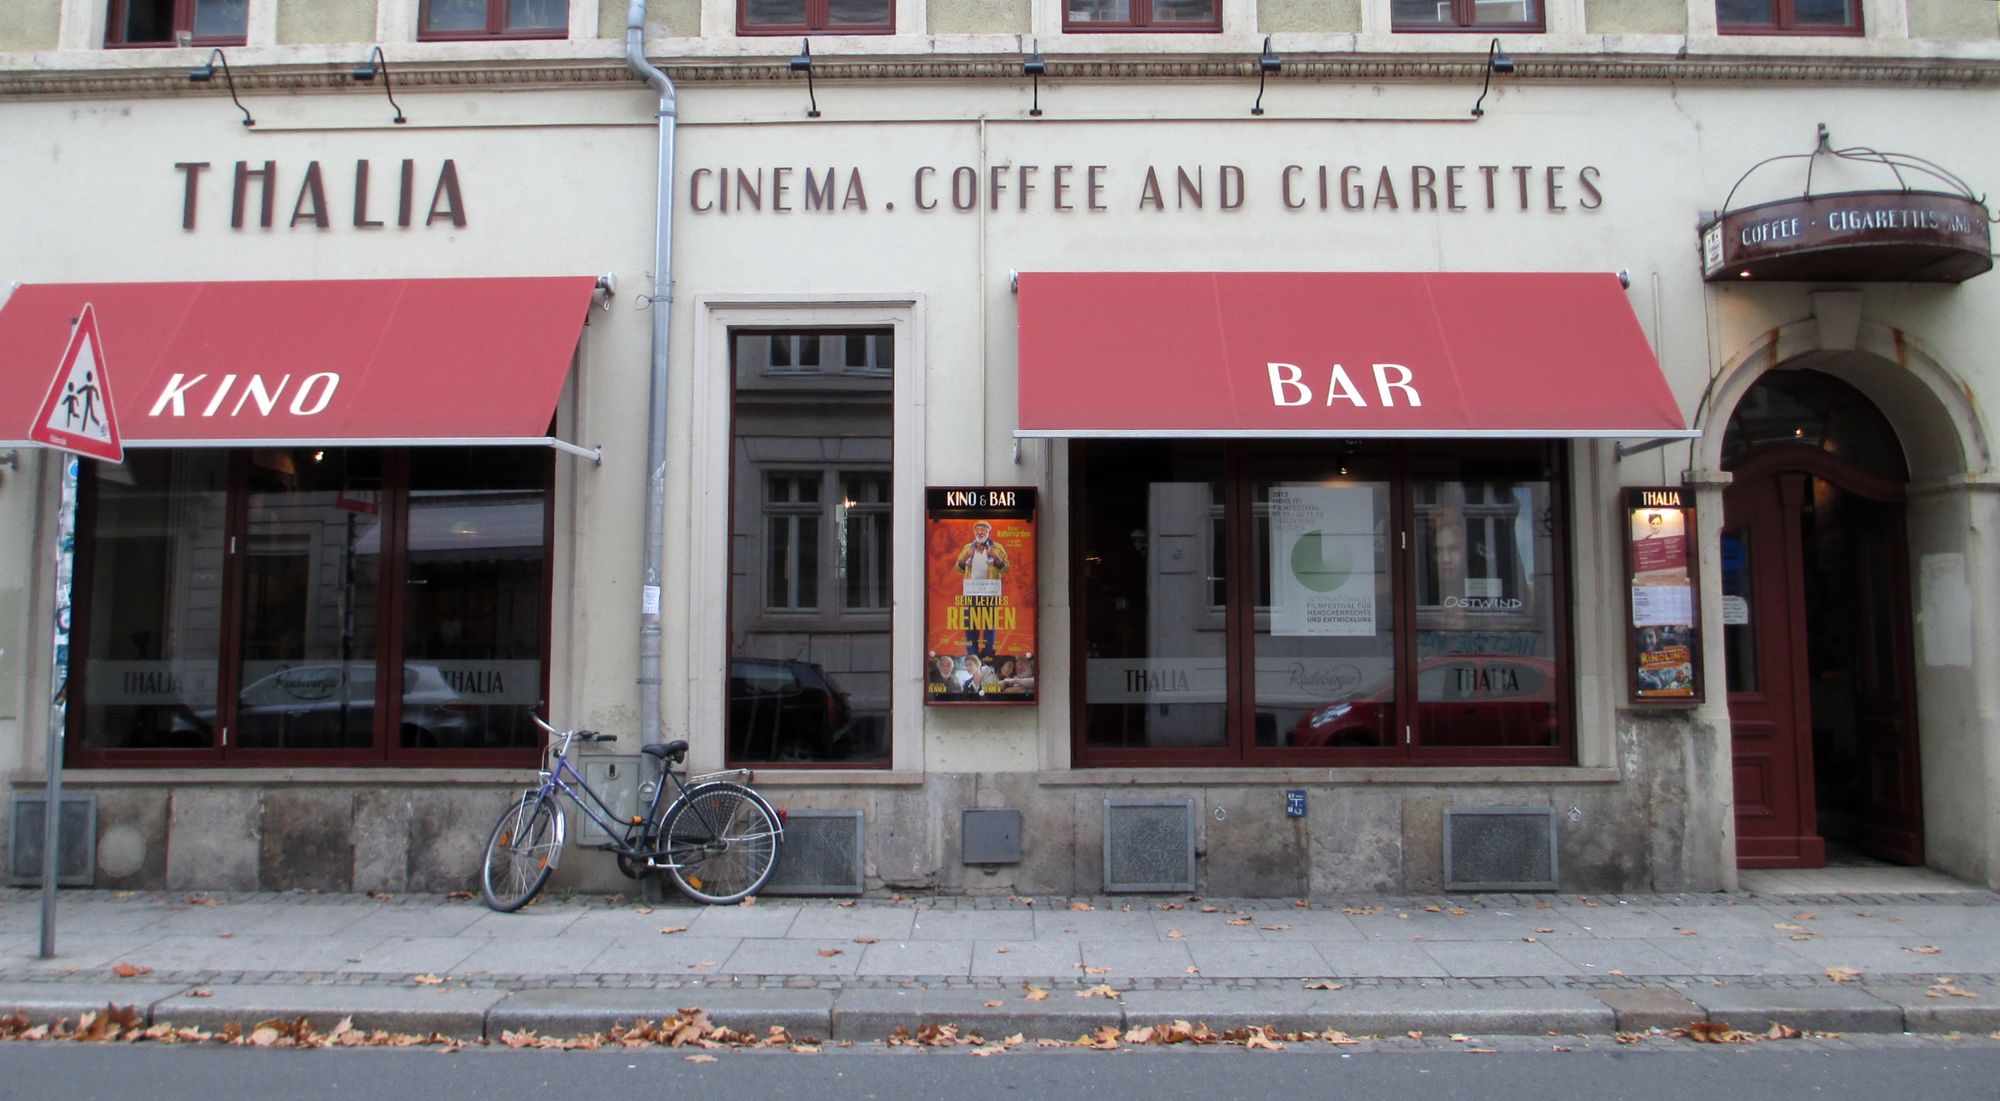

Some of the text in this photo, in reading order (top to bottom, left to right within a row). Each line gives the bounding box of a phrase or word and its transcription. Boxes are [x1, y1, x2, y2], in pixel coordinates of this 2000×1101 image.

[174, 158, 467, 230] THALIA
[914, 165, 1108, 210] COFFEE
[1138, 165, 1246, 211] AND
[1282, 164, 1603, 210] CIGARETTES
[1741, 217, 1799, 247] COFFEE
[148, 371, 341, 417] KINO
[1266, 362, 1422, 407] BAR
[946, 490, 1016, 507] KINO & BAR
[1641, 490, 1681, 506] THALIA
[954, 595, 1009, 606] SEIN LETZTES
[946, 606, 1016, 631] RENNEN
[1640, 651, 1689, 665] KINOLINO
[120, 671, 184, 694] THALIA
[1123, 668, 1189, 692] THALIA
[1453, 667, 1520, 691] THALIA
